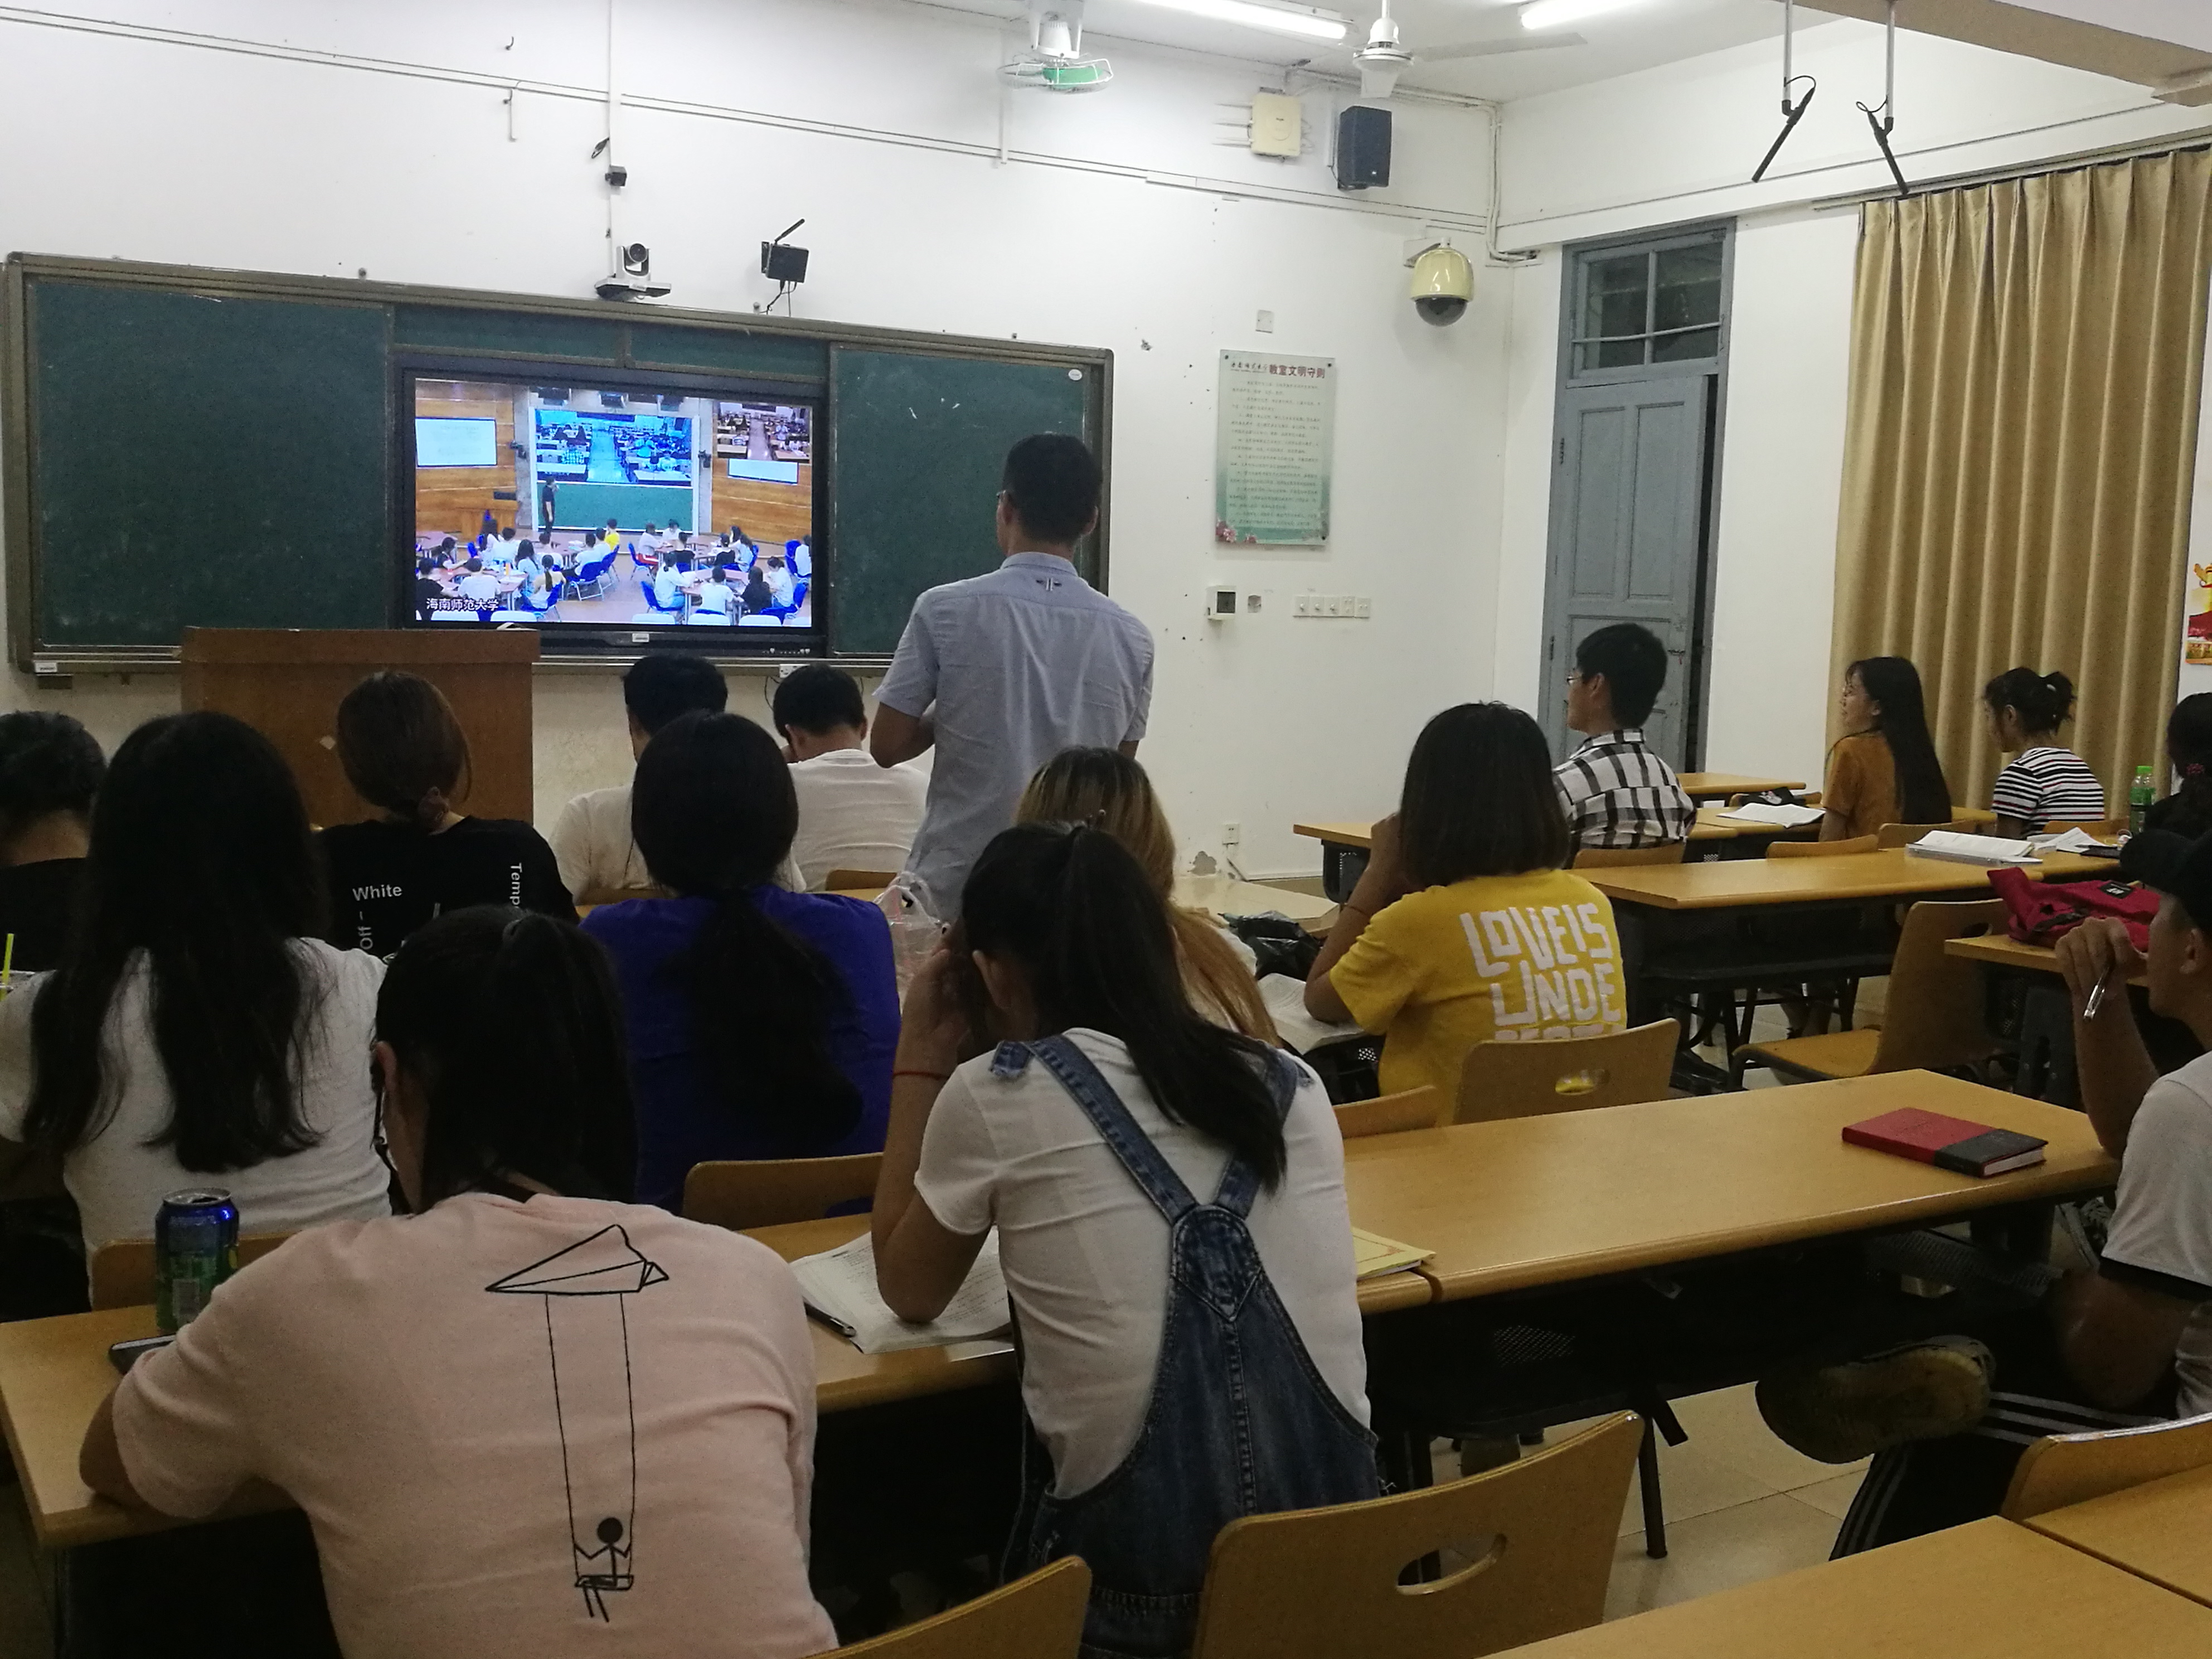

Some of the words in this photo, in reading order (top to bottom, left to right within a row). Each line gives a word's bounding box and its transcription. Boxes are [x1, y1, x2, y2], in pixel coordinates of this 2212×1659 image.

[1269, 364, 1325, 379] 教室文明守则
[426, 598, 499, 611] 海南师范大学
[352, 884, 402, 901] White
[510, 862, 522, 908] Temp
